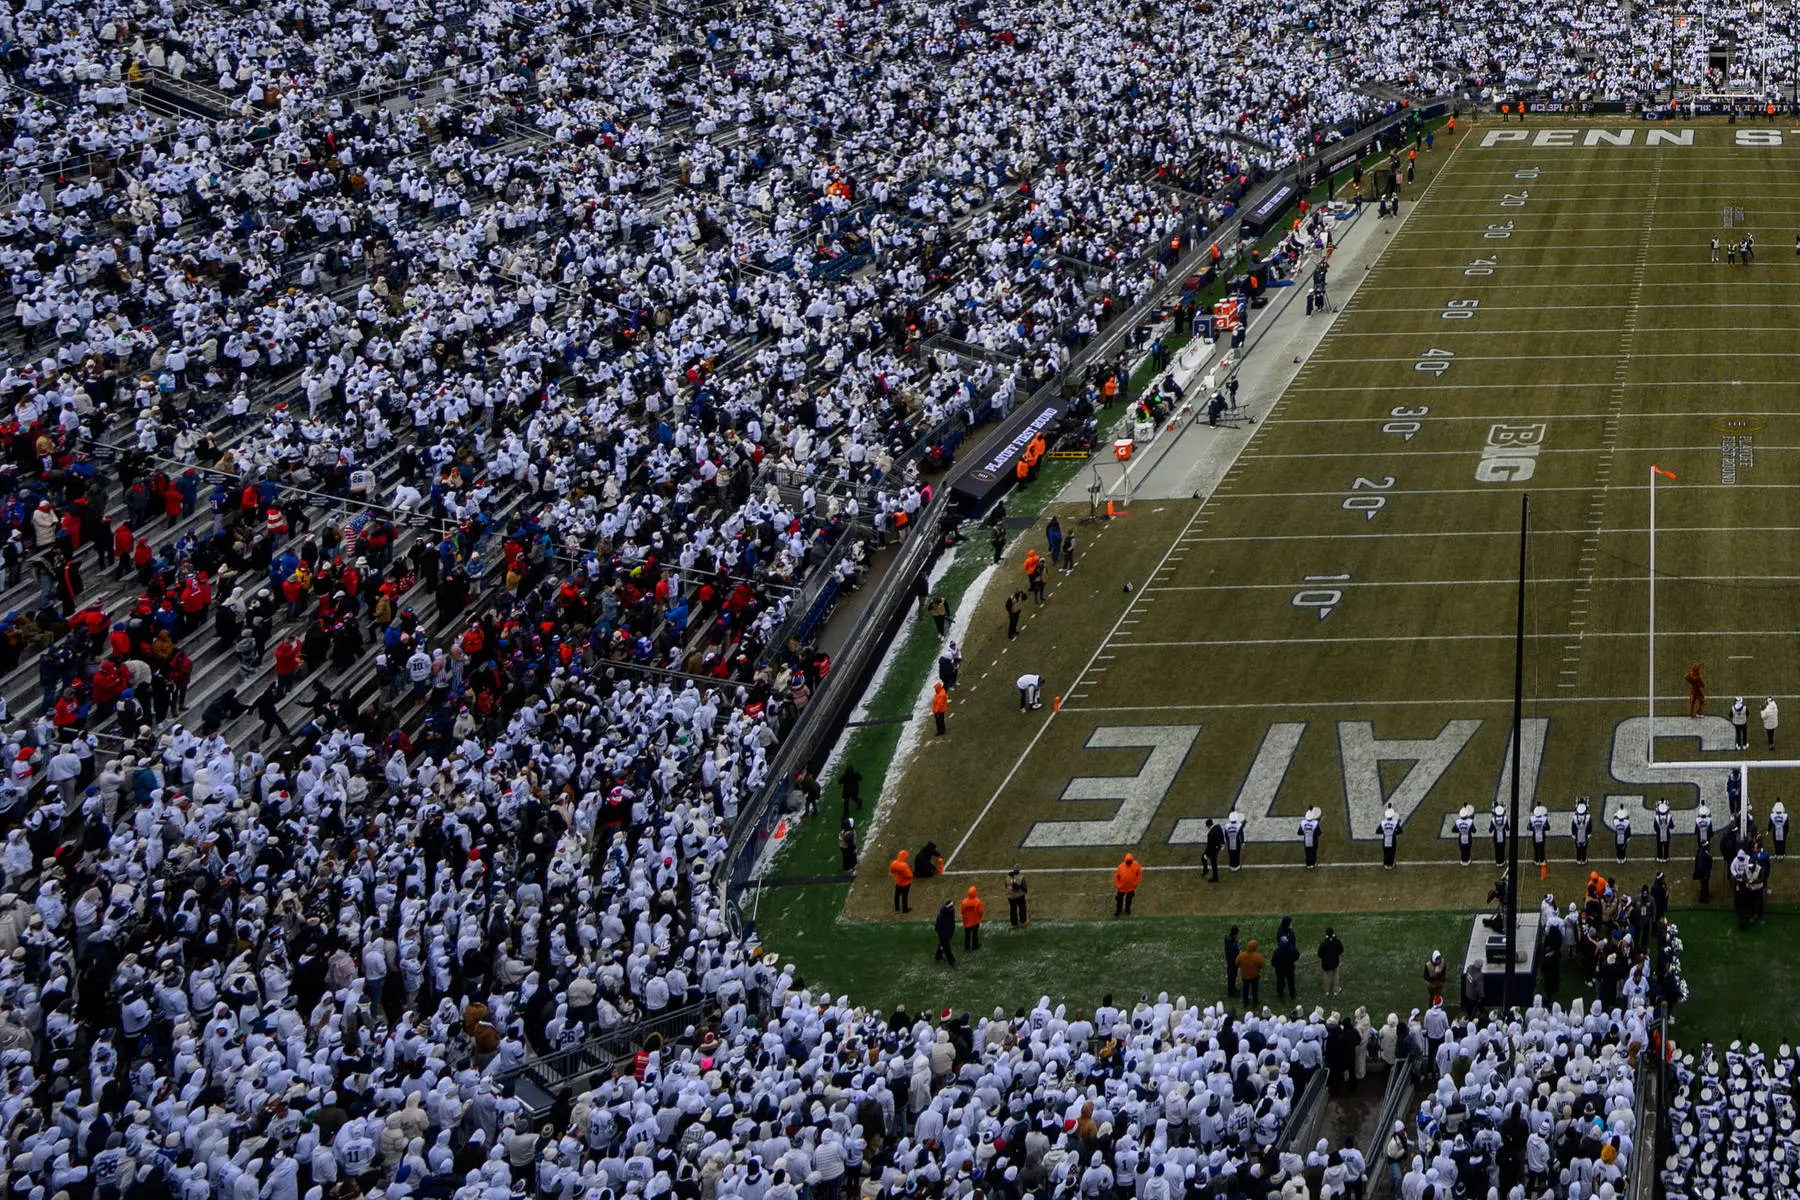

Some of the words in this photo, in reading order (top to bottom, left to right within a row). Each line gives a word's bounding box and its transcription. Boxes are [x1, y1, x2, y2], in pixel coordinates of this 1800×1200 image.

[1479, 128, 1695, 147] PENN
[1499, 193, 1529, 207] 20
[1483, 223, 1515, 239] 30
[1463, 258, 1498, 276] 40
[1440, 298, 1480, 320] 50
[1413, 347, 1455, 374] 40
[1381, 404, 1430, 435] 30
[352, 475, 363, 483] 26
[1340, 475, 1398, 511] 20
[1290, 572, 1353, 609] 10
[412, 662, 423, 671] 10
[1020, 715, 1742, 848] STATE
[734, 1011, 739, 1024] 1
[1033, 1018, 1043, 1030] 15
[1101, 1015, 1106, 1026] 1
[561, 1031, 575, 1043] 26
[1446, 1049, 1450, 1062] 1
[347, 1150, 360, 1163] 11
